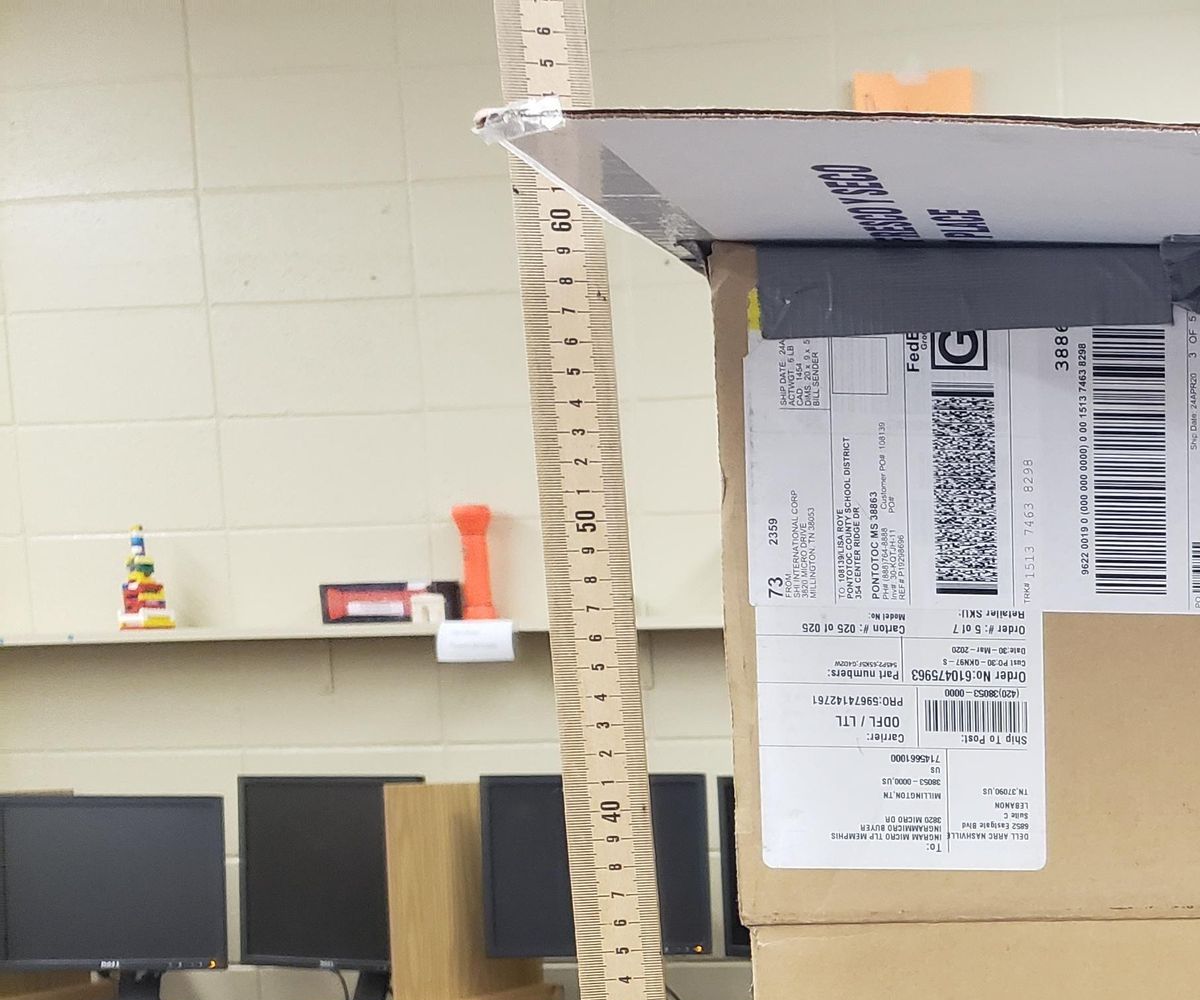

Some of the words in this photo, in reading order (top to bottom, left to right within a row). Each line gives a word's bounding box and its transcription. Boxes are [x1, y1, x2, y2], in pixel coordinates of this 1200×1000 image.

[811, 165, 889, 196] SECO
[551, 209, 571, 232] 60
[927, 209, 993, 238] PLACE
[1189, 329, 1197, 343] OF
[787, 346, 794, 356] LB
[1078, 343, 1086, 367] 8298
[804, 371, 811, 380] 20
[1078, 370, 1086, 392] 7463
[779, 386, 787, 405] SHIP
[1189, 373, 1197, 409] 24APR20
[1078, 396, 1087, 418] 1513
[1079, 422, 1087, 433] 00
[843, 437, 851, 475] DISTRICT
[1079, 444, 1089, 471] 0000)
[1023, 459, 1033, 492] 8298
[1079, 475, 1088, 492] 000
[844, 477, 852, 512] SCHOOL
[790, 490, 798, 514] CORP
[870, 492, 878, 520] 38863
[1079, 495, 1090, 515] (000
[853, 507, 860, 519] DR
[1024, 503, 1034, 535] 7463
[576, 510, 596, 533] 50
[768, 518, 778, 545] 2359
[853, 521, 861, 546] RIDGE
[870, 523, 878, 538] MS
[1080, 526, 1089, 549] 0019
[808, 532, 815, 545] TN
[791, 516, 799, 582] INTERNATIONAL
[800, 550, 808, 577] MICRO
[1025, 546, 1035, 579] 1513
[1080, 553, 1089, 575] 9622
[870, 542, 879, 599] PONTOTOC
[768, 577, 783, 598] 73
[792, 584, 800, 598] SHI
[884, 613, 905, 621] Model
[802, 623, 820, 633] 025
[824, 623, 833, 633] of
[837, 624, 855, 633] 025
[872, 624, 905, 634] Carton
[953, 625, 958, 633] 7
[963, 625, 972, 634] of
[975, 625, 981, 634] 5
[998, 625, 1026, 634] Order
[827, 669, 875, 679] numbers:
[880, 670, 899, 679] Part
[911, 669, 991, 681] No:610475963
[995, 670, 1026, 681] Order
[812, 695, 903, 706] PRO:59674142761
[836, 715, 856, 726] LTL
[869, 716, 900, 727] ODFL
[867, 733, 904, 743] Carrier:
[961, 734, 985, 744] Post:
[989, 735, 1001, 743] To
[1006, 734, 1027, 744] Ship
[890, 754, 940, 762] 7145661000
[600, 800, 620, 823] 40
[885, 833, 909, 841] MICRO
[911, 833, 941, 841] INGRAM
[988, 833, 1008, 841] ARRC
[926, 843, 942, 852] To:
